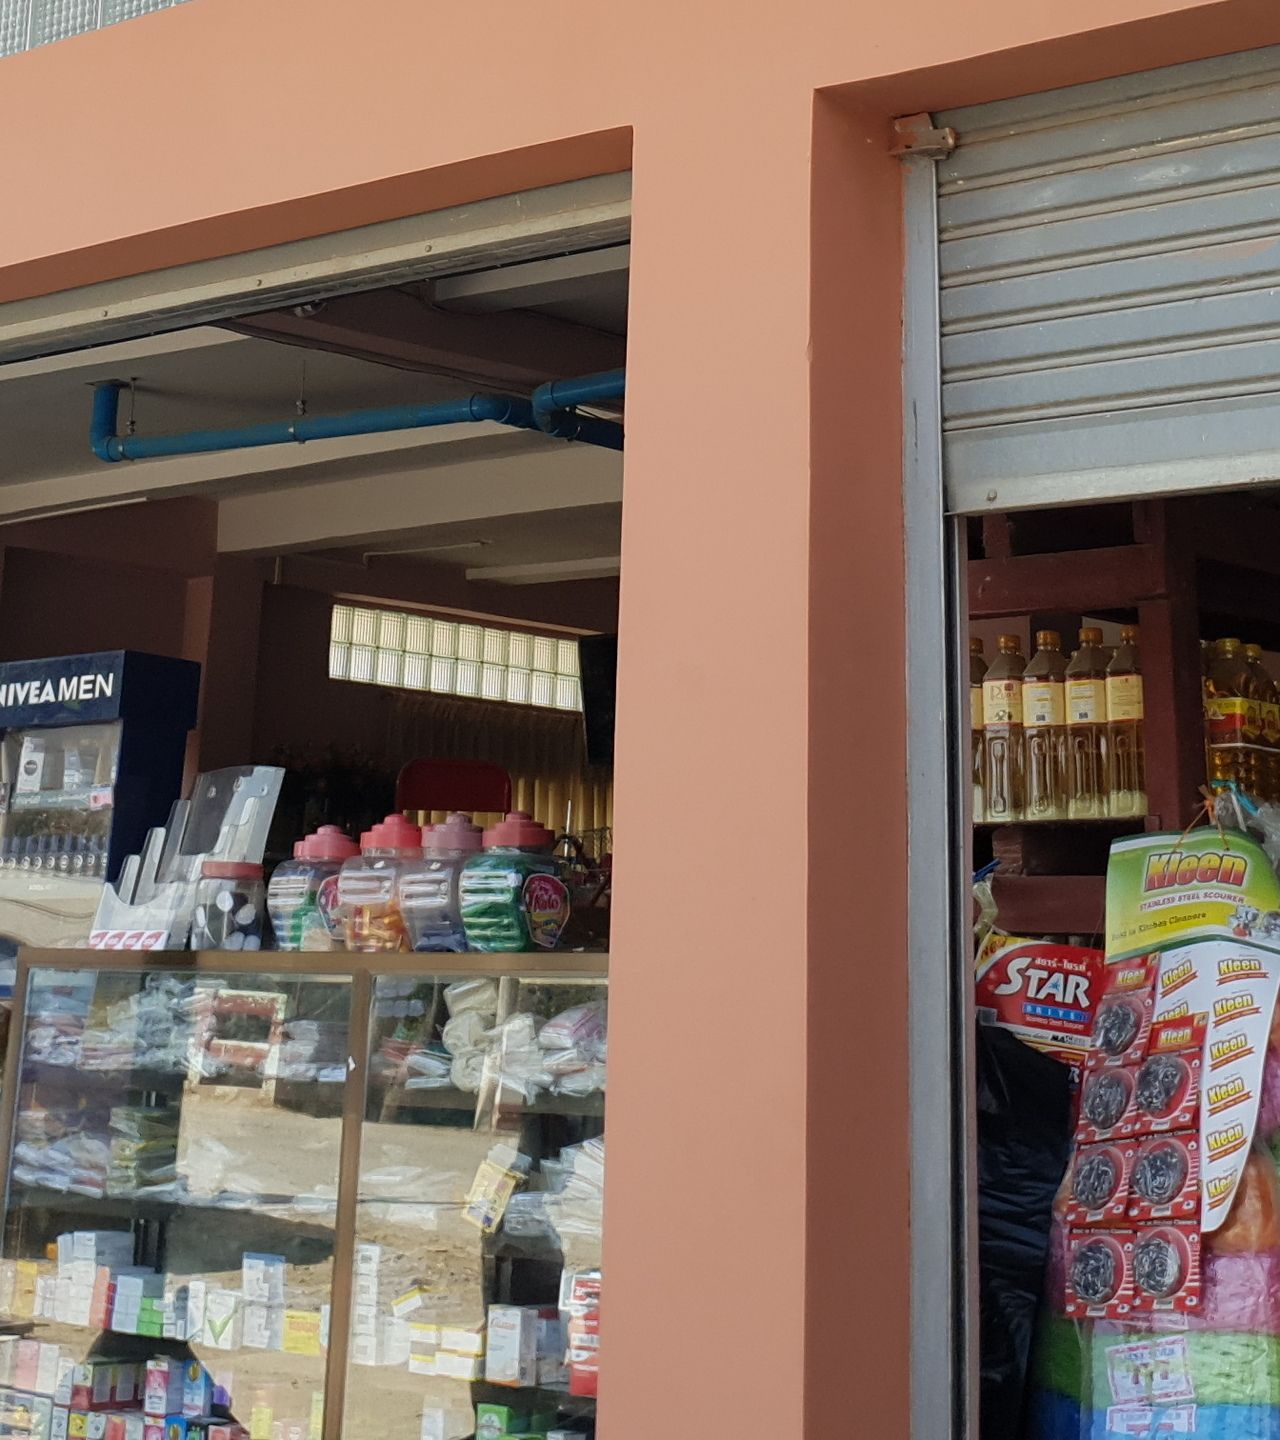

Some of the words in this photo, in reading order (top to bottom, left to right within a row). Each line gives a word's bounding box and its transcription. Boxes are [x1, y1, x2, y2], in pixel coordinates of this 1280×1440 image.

[58, 673, 115, 702] MEN
[1143, 851, 1248, 893] Kleen
[1177, 892, 1200, 903] STEEL
[1203, 891, 1246, 904] SCOURER
[1161, 960, 1193, 990] Kleen
[1218, 958, 1262, 976] Kleen
[993, 956, 1091, 1009] STAR
[1213, 993, 1255, 1017] Kleen
[1159, 1028, 1192, 1046] Kleen
[1209, 1033, 1248, 1062] Kleen
[1207, 1076, 1246, 1107] Kleen
[1206, 1122, 1244, 1153] Kleen
